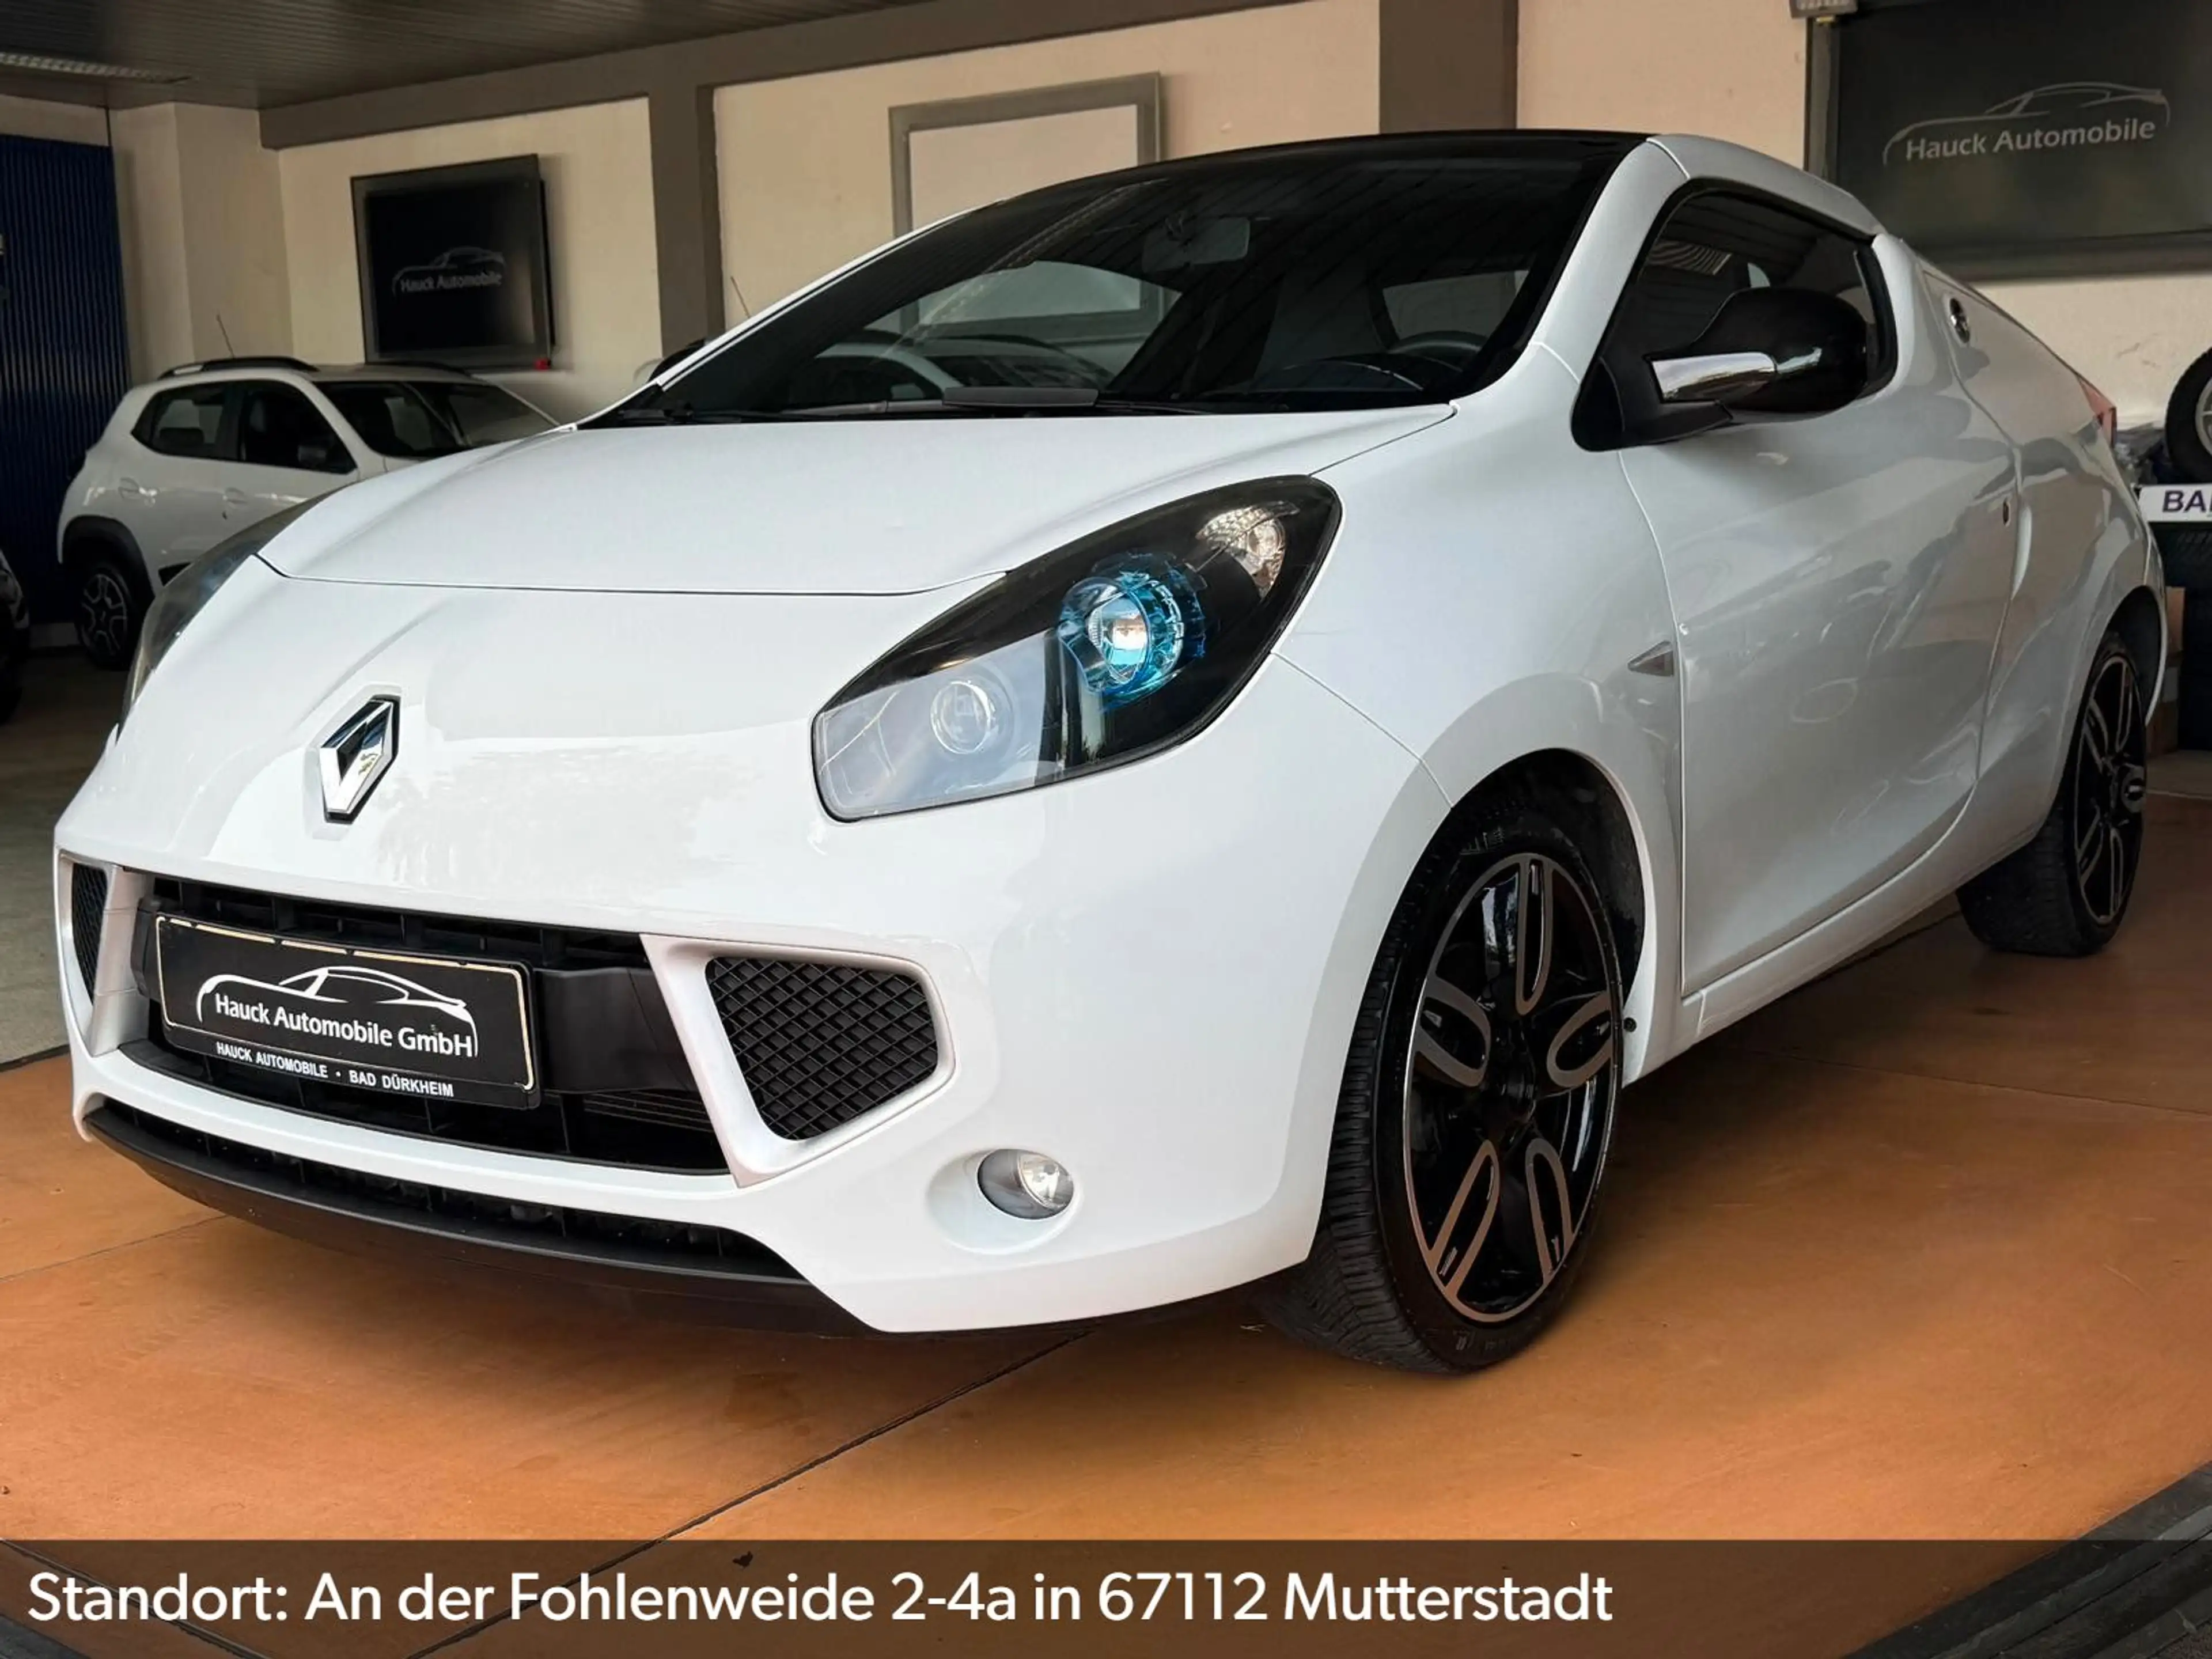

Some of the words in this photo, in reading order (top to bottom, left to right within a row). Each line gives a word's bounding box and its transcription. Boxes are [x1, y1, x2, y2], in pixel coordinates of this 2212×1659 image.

[1906, 133, 1986, 160] Hauck
[1993, 118, 2156, 153] Automobile
[400, 277, 435, 293] Hauck
[437, 271, 503, 290] Automobile
[2162, 489, 2212, 513] BA
[215, 993, 271, 1025] Hauck
[273, 1006, 393, 1047] Automobile
[397, 1027, 472, 1058] GmbH
[216, 1041, 253, 1063] HAUCK
[255, 1051, 329, 1078] AUTOMOBILE
[349, 1070, 377, 1086] BAD
[381, 1073, 454, 1097] DÜRKHEIM
